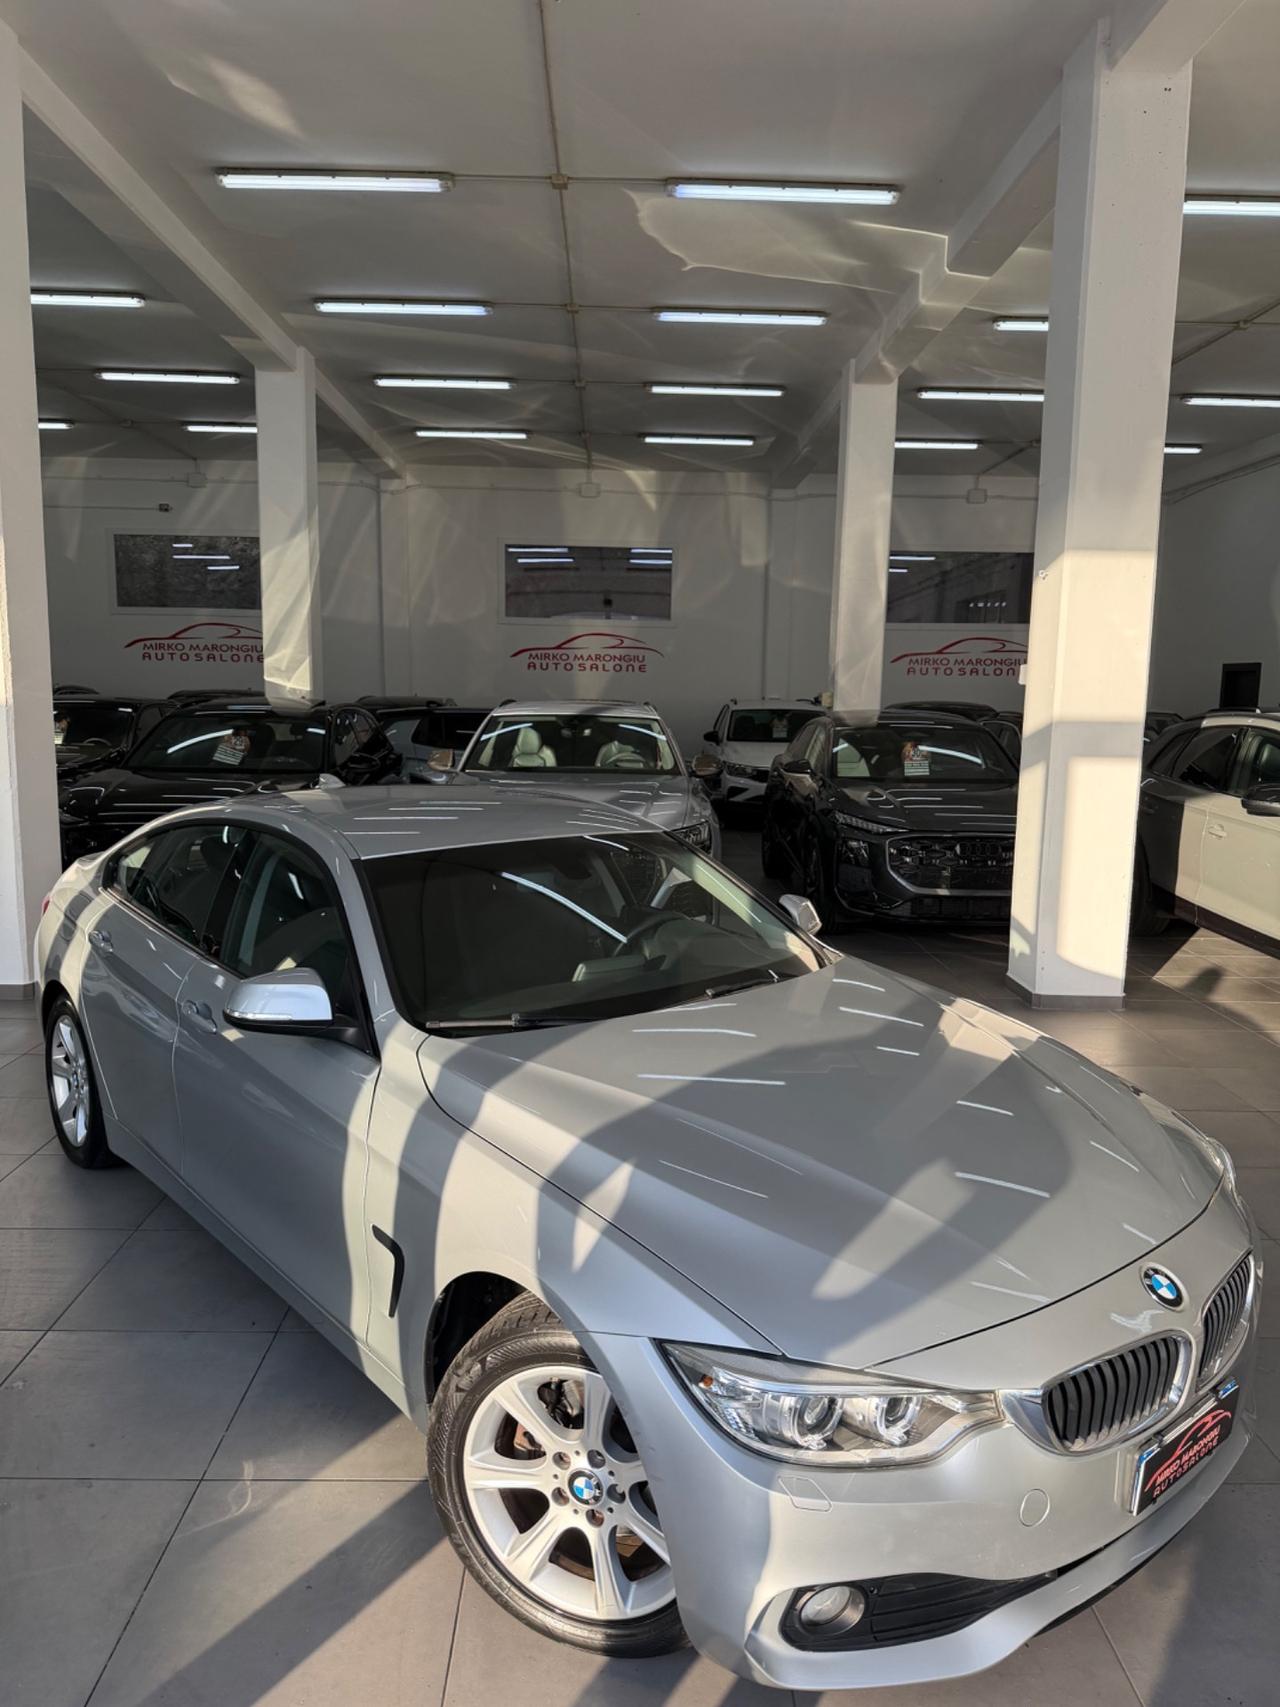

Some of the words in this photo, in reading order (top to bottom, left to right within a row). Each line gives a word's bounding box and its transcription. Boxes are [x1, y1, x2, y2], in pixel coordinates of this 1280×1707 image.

[142, 642, 186, 652] MIRKO
[188, 643, 264, 654] MARONGIU
[528, 652, 569, 662] MIRKO
[572, 653, 646, 663] MARONGIU
[908, 657, 950, 667] MIRKO
[527, 661, 648, 673] AUTOSALONE
[906, 666, 1016, 677] AUTOSALON
[1152, 1436, 1219, 1498] AUTOSALONE
